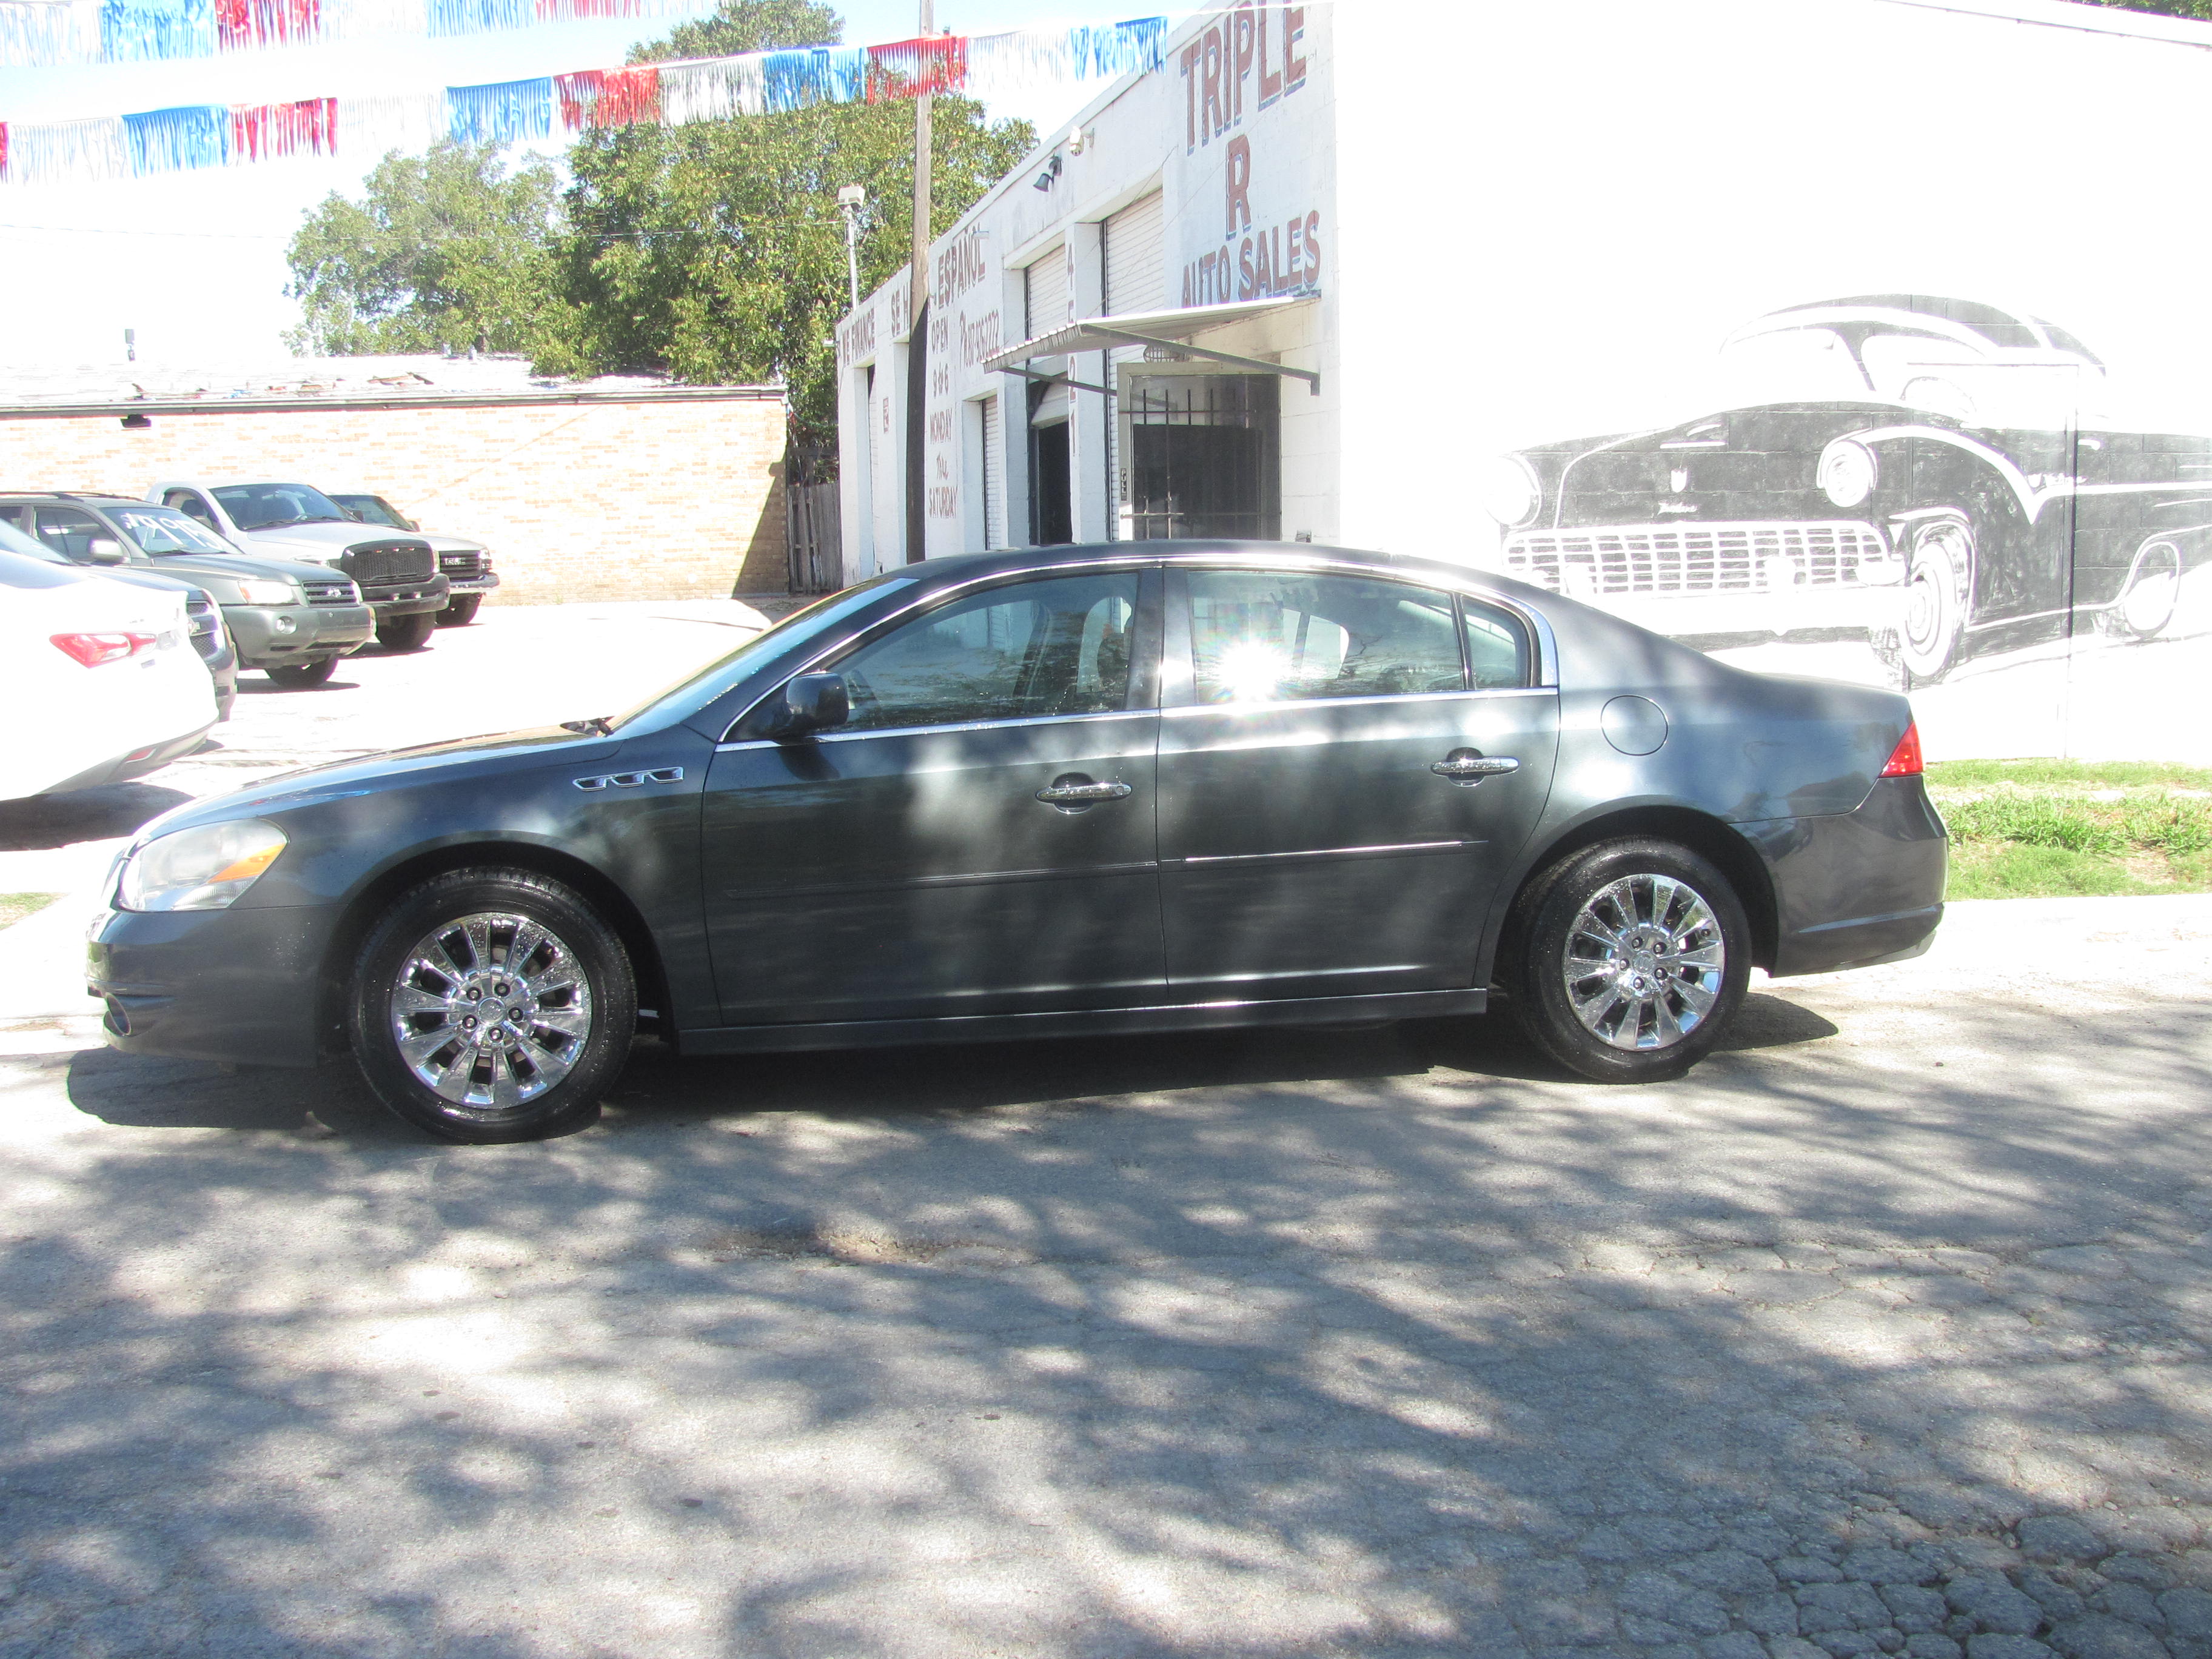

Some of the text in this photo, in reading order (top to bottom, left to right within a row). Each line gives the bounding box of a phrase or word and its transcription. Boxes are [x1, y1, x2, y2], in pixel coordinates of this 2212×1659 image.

[1181, 0, 1306, 156] TRIPLE
[1226, 134, 1252, 241] R
[1181, 210, 1321, 307] AUTO SALES
[851, 307, 875, 364] FINANCE
[891, 290, 900, 338] SE
[931, 315, 949, 354] OPEN
[933, 369, 937, 398] 9
[945, 363, 949, 395] 6
[930, 407, 953, 444] MONDAY
[929, 485, 958, 519] SATURDAY
